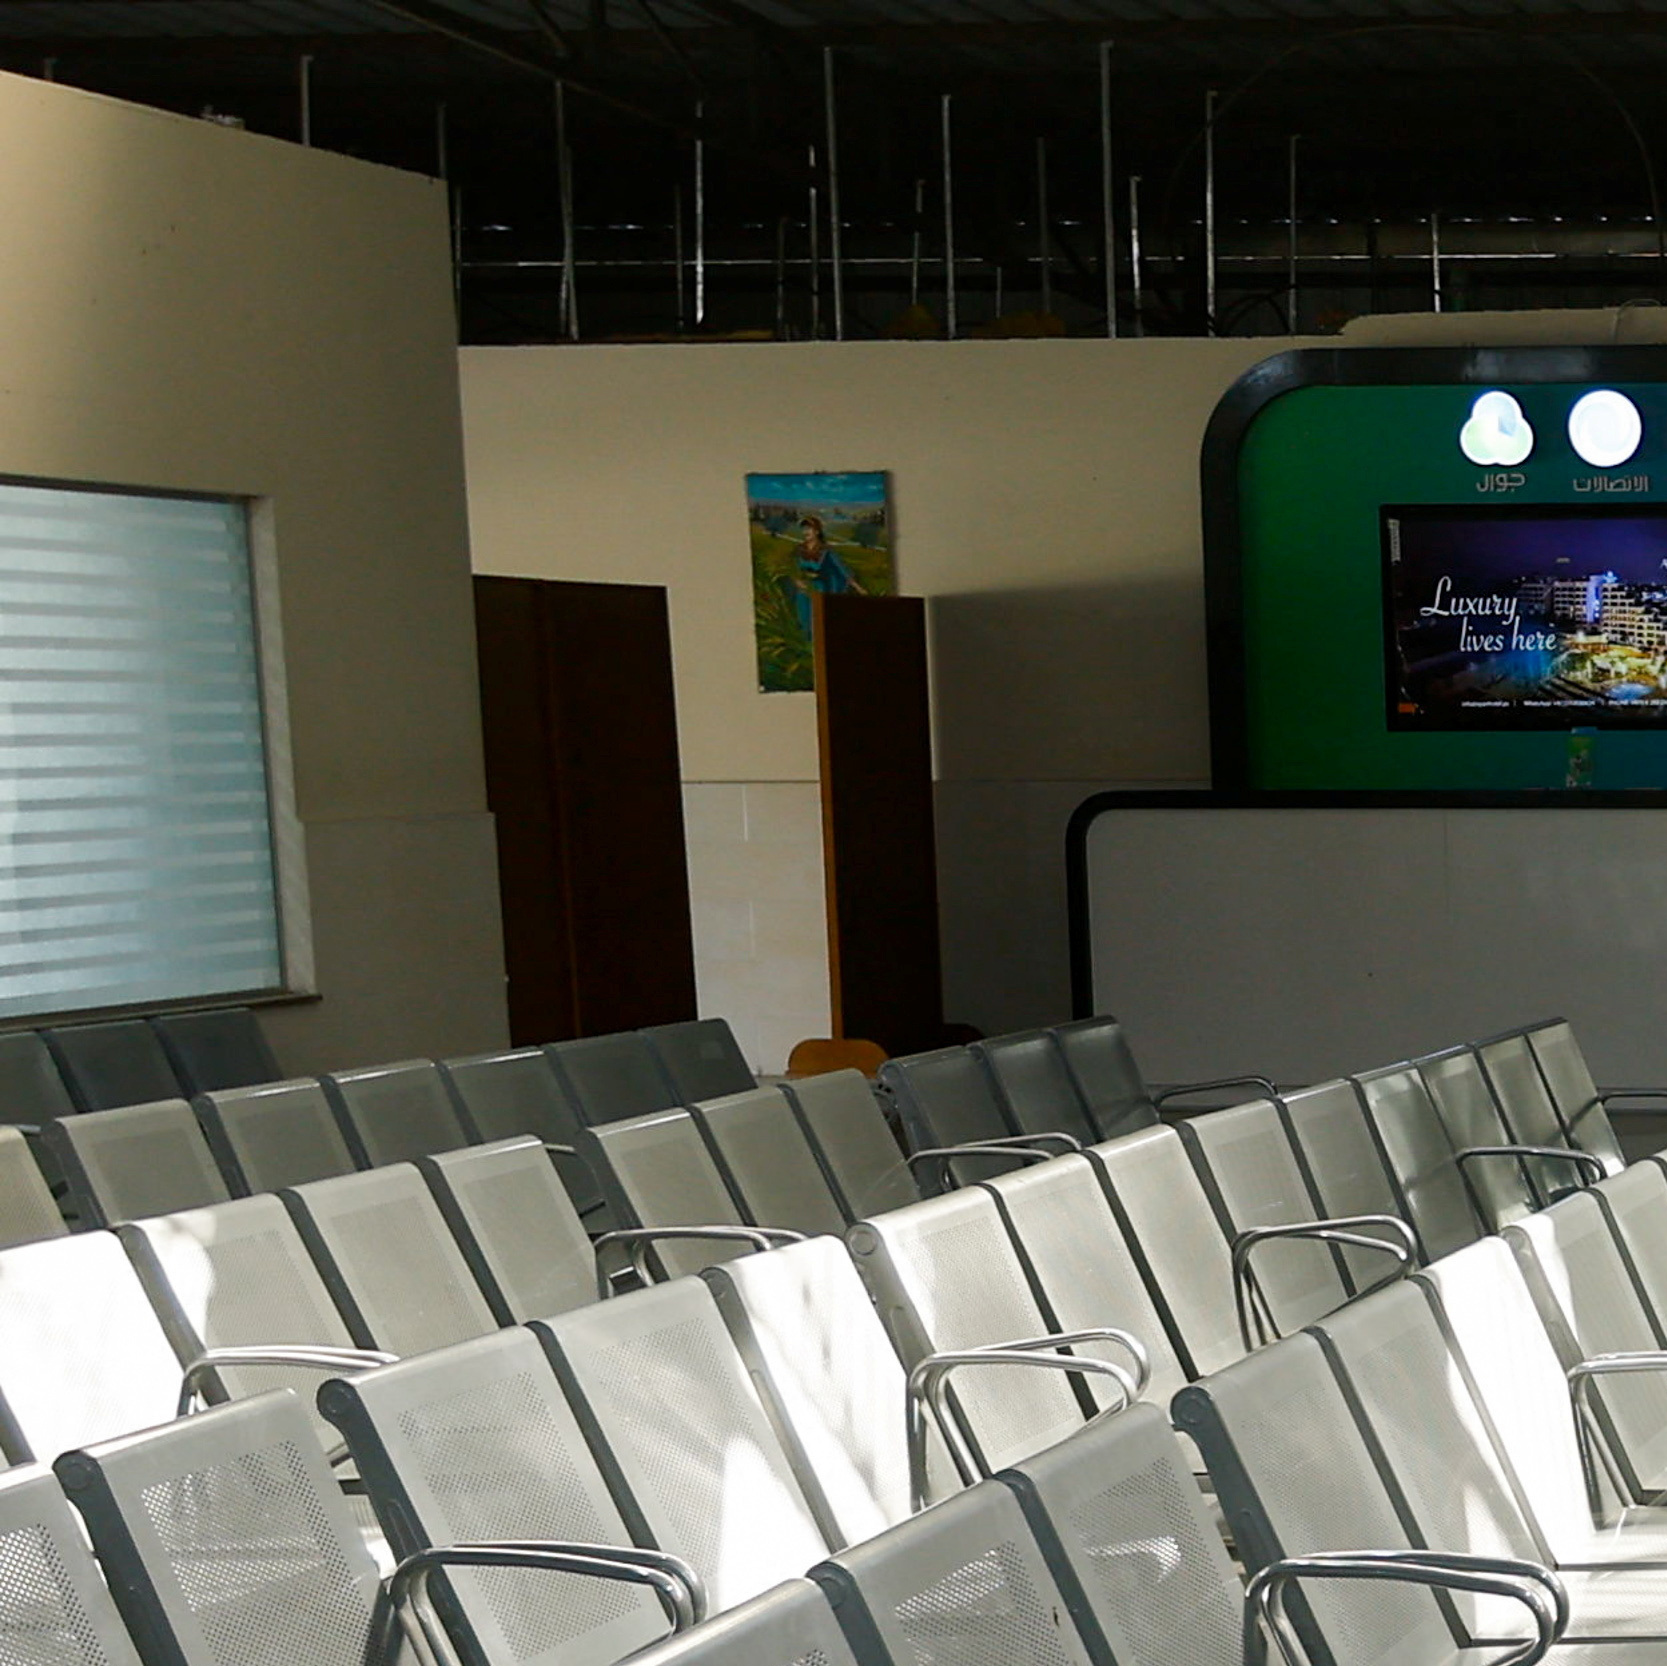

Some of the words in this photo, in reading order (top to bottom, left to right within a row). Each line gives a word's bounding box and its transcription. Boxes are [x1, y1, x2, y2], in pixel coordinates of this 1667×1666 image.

[1475, 472, 1526, 493] جوال
[1572, 475, 1649, 493] الاتصالات
[1420, 576, 1518, 625] Luxury
[1460, 616, 1505, 652] lives
[1511, 616, 1557, 651] here
